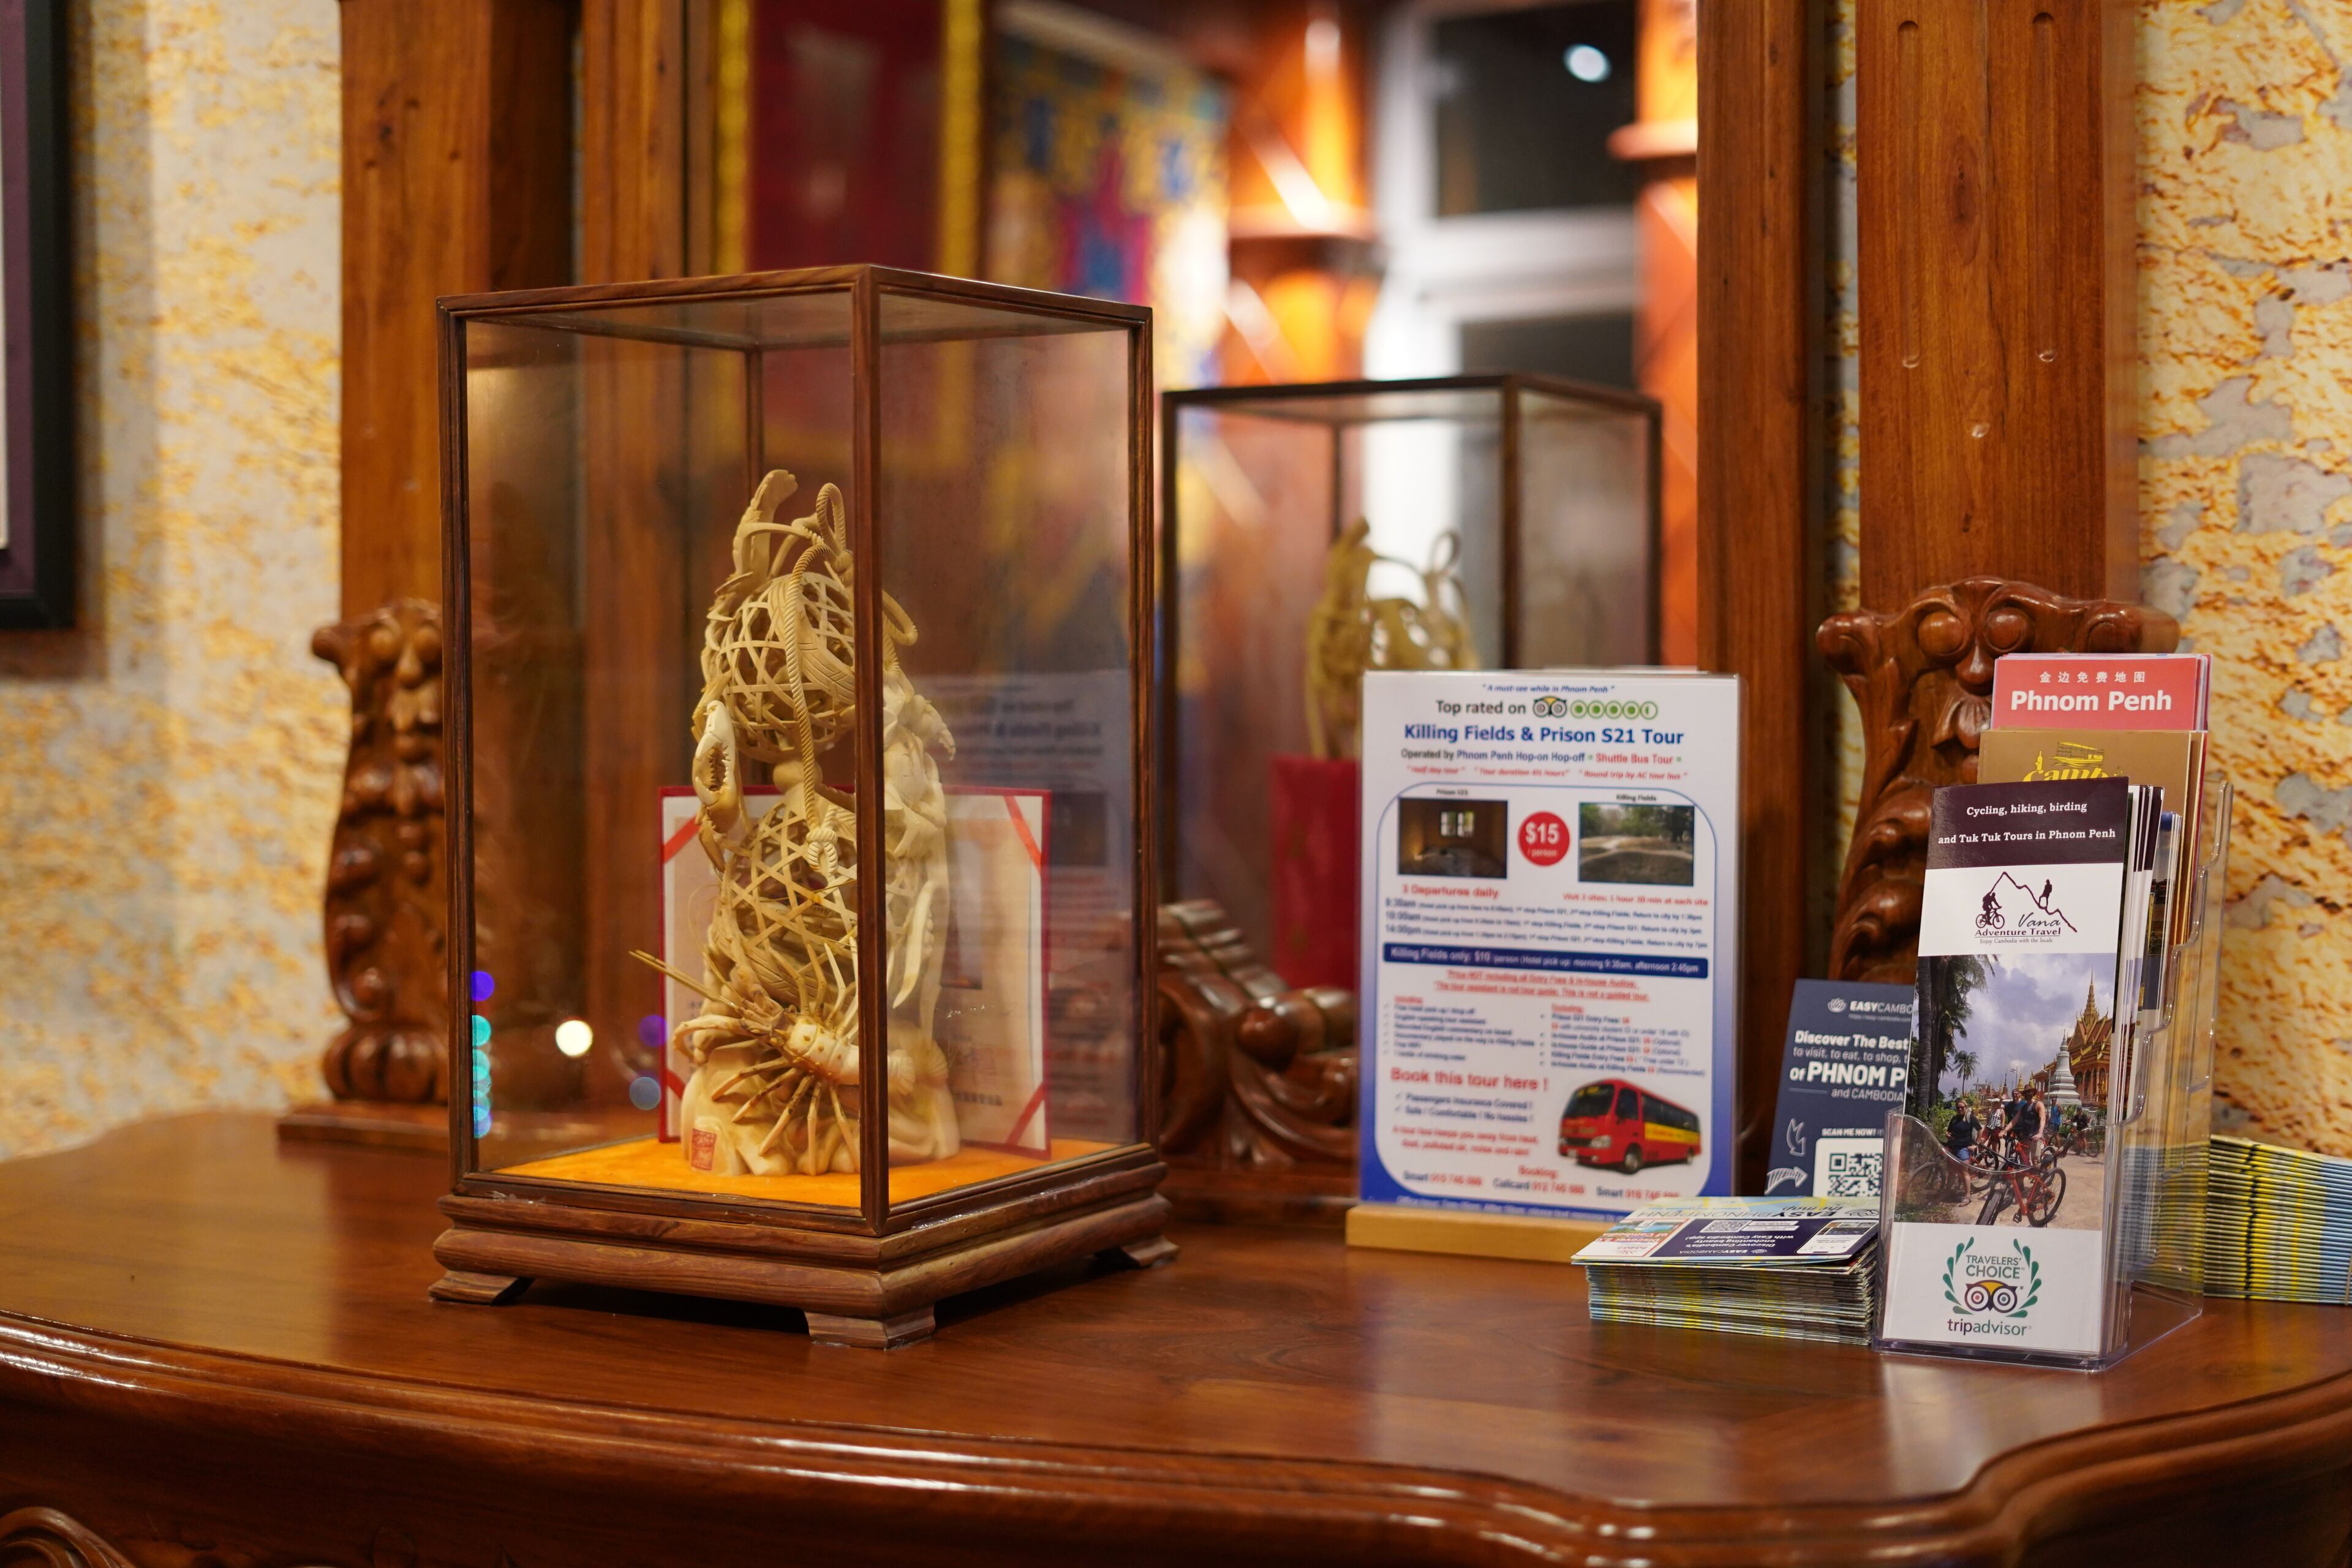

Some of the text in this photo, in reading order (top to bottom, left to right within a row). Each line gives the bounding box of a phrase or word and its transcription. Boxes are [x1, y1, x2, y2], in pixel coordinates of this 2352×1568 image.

[2039, 671, 2146, 683] 金边免费地图
[2010, 690, 2171, 710] Phnom Penh
[1436, 701, 1526, 716] Top rated on
[1404, 725, 1684, 744] Killing Fields & Prison S21 Tour
[1401, 749, 1673, 764] Operated by Phnom Penh Hop-on Hop-off Shuttle Bus Tour
[1610, 771, 1623, 779] trip
[1966, 801, 2087, 817] Cycling, hiking, birding
[1525, 823, 1561, 845] $15
[1938, 828, 2116, 844] and Tuk Tuk Tours in Phnom Penh
[1532, 850, 1558, 858] person
[1411, 885, 1470, 898] Departures
[1472, 888, 1498, 899] daily
[2018, 912, 2061, 927] Vana
[2030, 927, 2061, 936] Travel
[1421, 949, 1448, 959] Fields
[1573, 957, 1604, 969] morning
[1634, 960, 1670, 970] afternoon
[1793, 1030, 1910, 1051] Discover The Best
[1793, 1047, 1901, 1066] to visit, to eat, to shop,
[1390, 1068, 1430, 1082] Book
[1434, 1071, 1463, 1085] this
[1468, 1073, 1498, 1087] tour
[1503, 1076, 1539, 1089] here
[1807, 1061, 1887, 1087] PHNOM
[1831, 1088, 1905, 1101] and CAMBODIA
[1822, 1128, 1842, 1136] SCAN
[1403, 1171, 1428, 1182] Smart
[1596, 1187, 1622, 1197] Smart
[1947, 1319, 2027, 1336] tripadvisor
